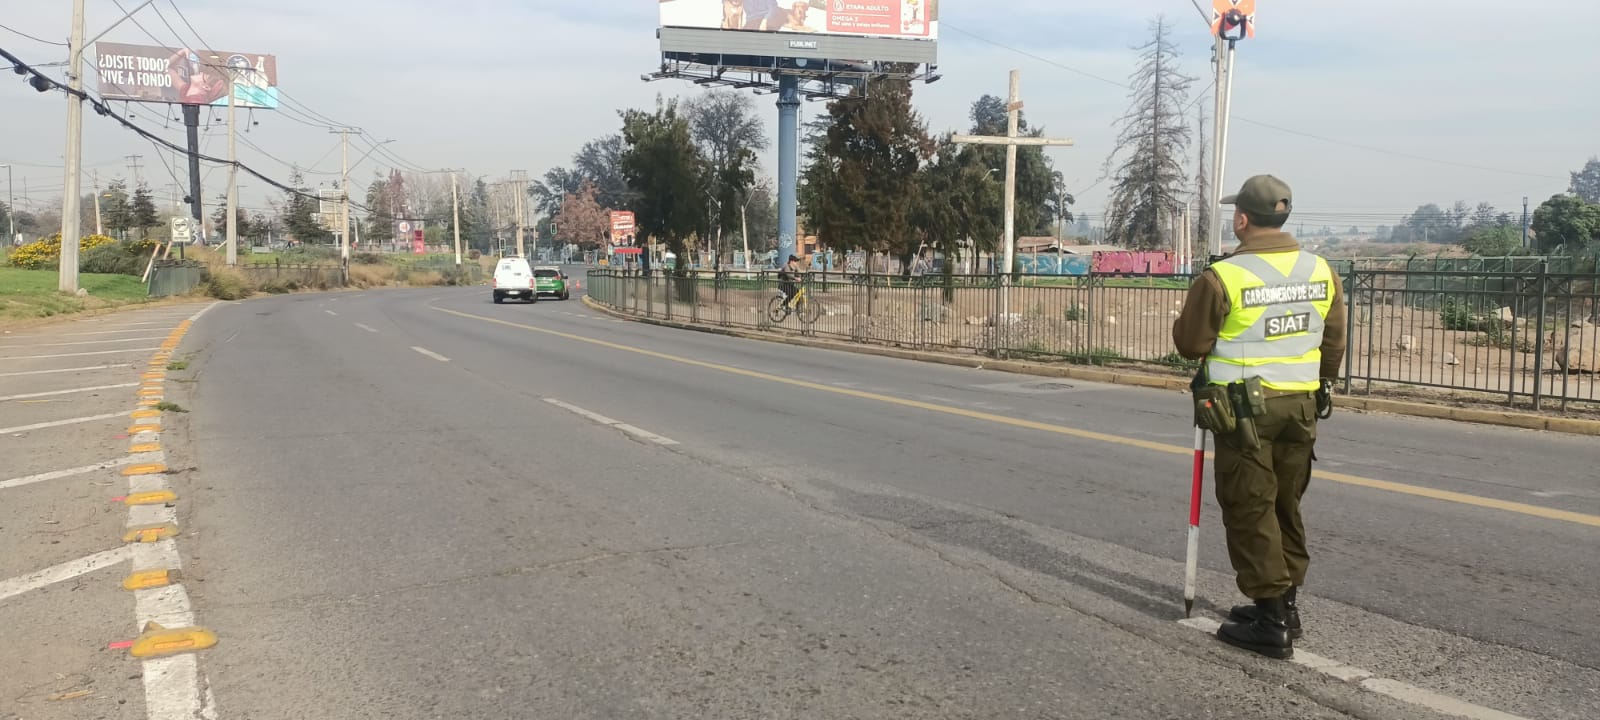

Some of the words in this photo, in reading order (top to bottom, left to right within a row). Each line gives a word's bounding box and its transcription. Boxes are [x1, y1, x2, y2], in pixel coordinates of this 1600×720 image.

[99, 54, 135, 69] ¿DISTE
[136, 56, 170, 73] TODO?
[100, 70, 125, 84] VIVE
[127, 71, 135, 85] A
[137, 71, 172, 88] FONDO
[1244, 286, 1297, 305] CARABINEROS
[1297, 285, 1307, 300] DE
[1308, 283, 1326, 299] CHILE
[1268, 314, 1306, 334] SIAT
